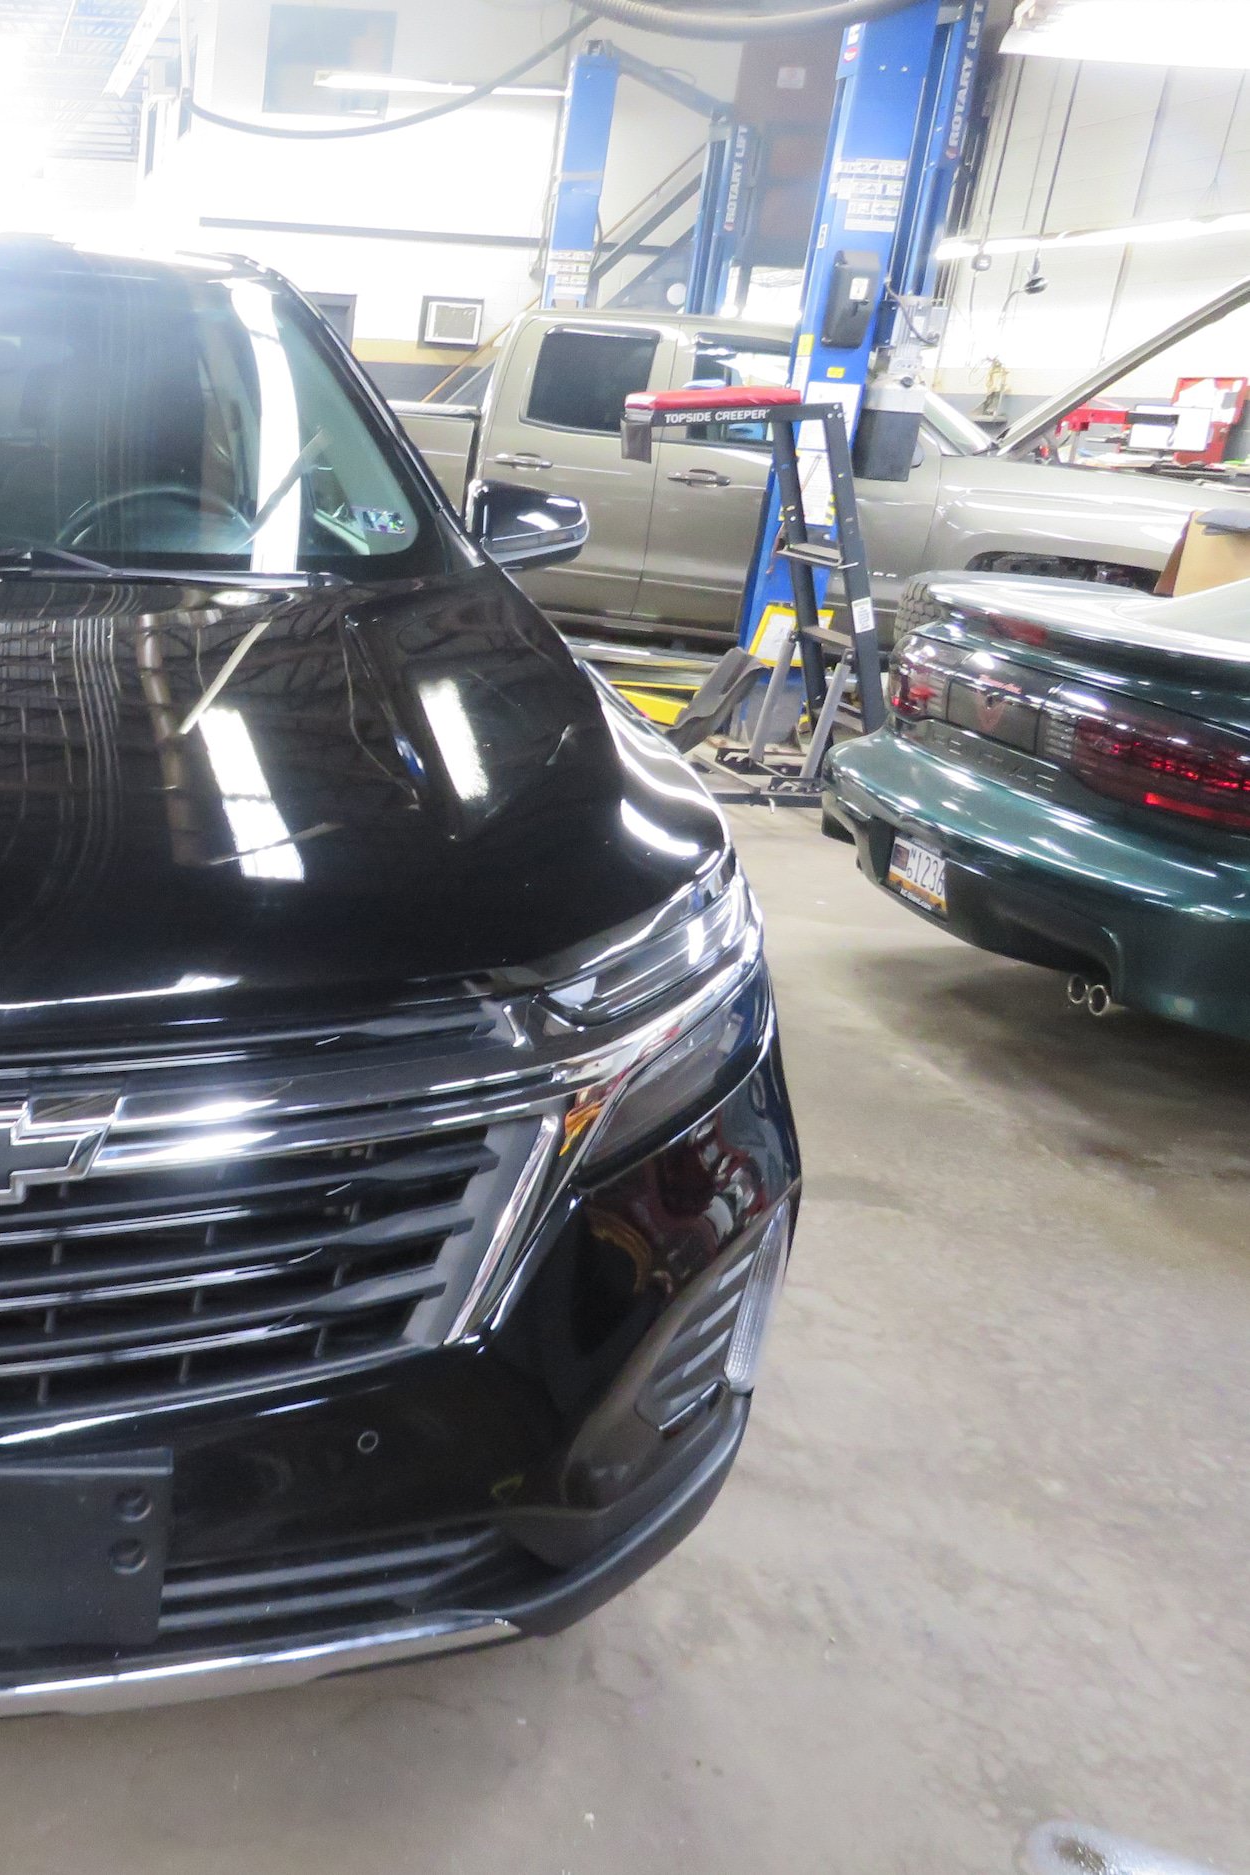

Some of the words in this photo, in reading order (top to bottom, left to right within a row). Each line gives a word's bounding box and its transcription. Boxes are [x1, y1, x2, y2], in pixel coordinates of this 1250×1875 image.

[949, 56, 973, 147] ROTARY
[966, 0, 984, 49] LIFT
[725, 162, 743, 223] ROTARY
[735, 125, 748, 157] LIFT
[664, 411, 711, 423] TOPSIDE
[715, 409, 768, 421] CREEPER
